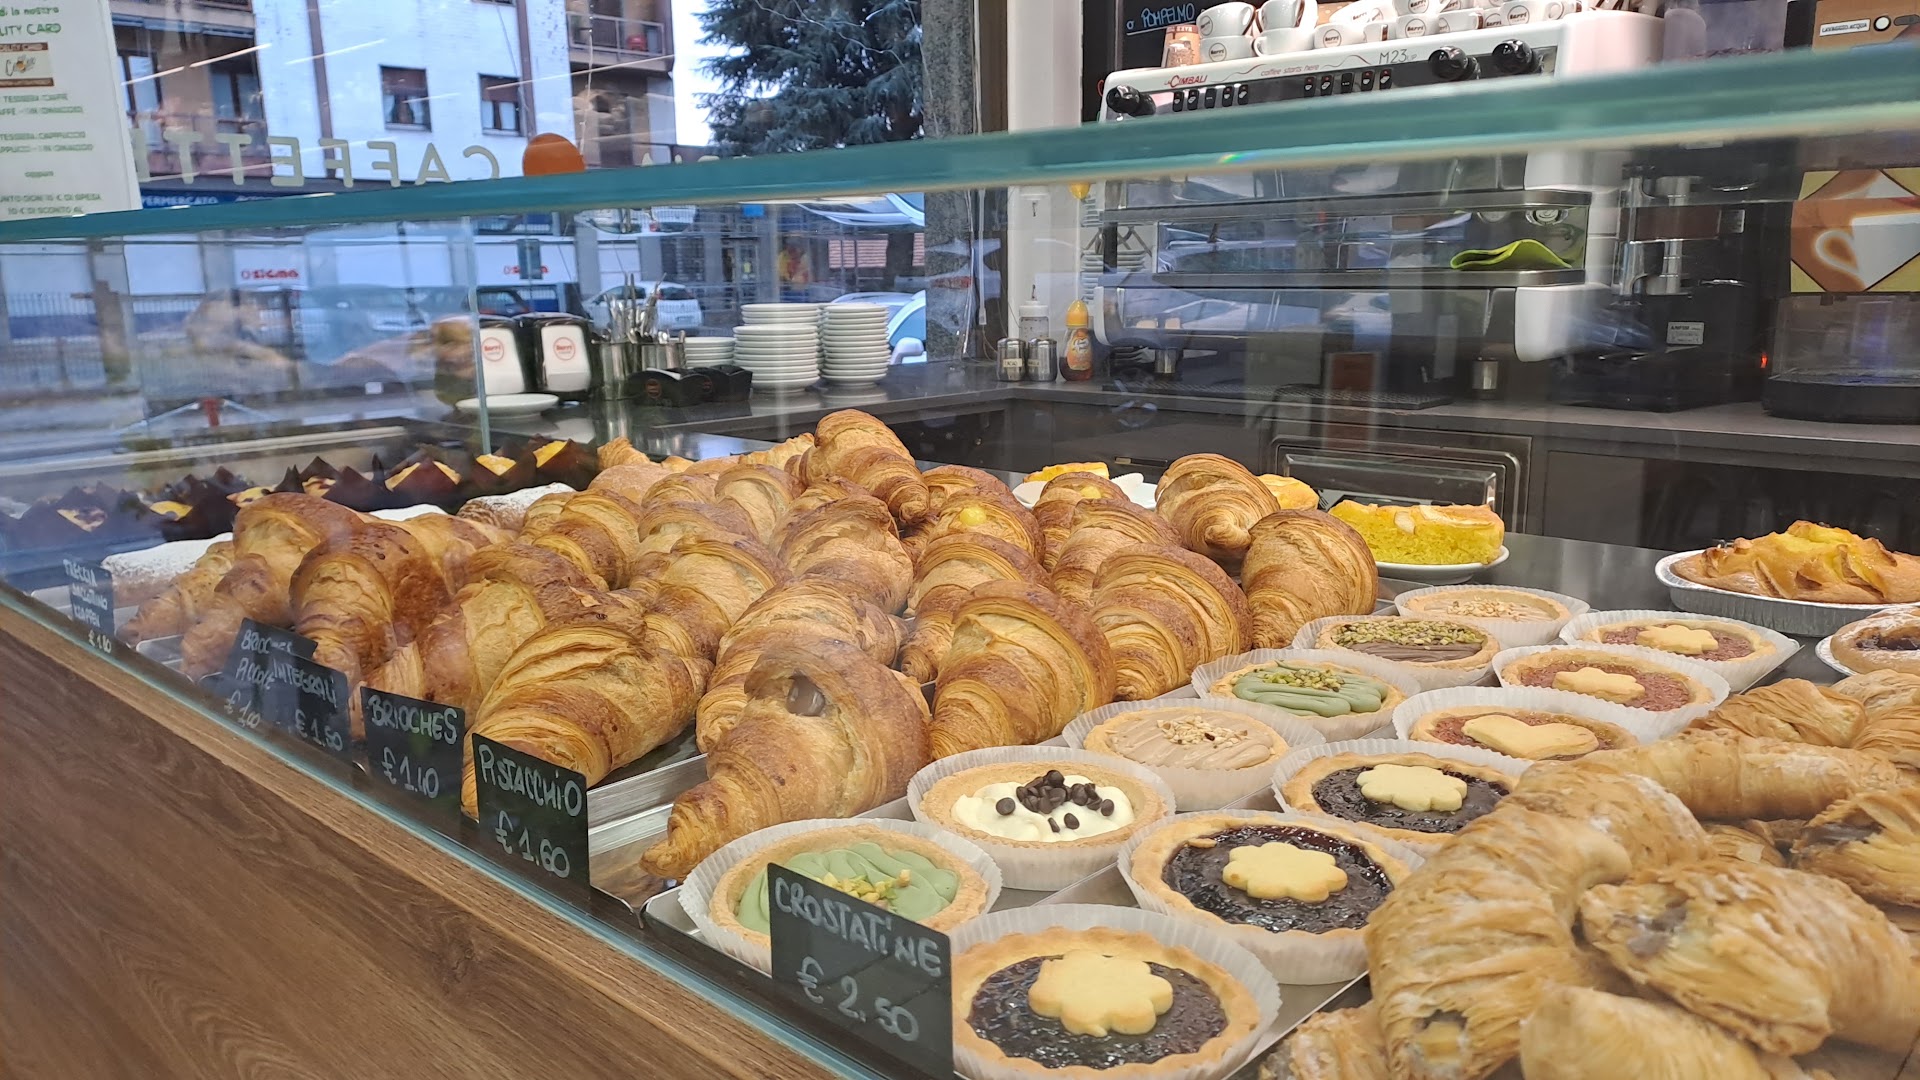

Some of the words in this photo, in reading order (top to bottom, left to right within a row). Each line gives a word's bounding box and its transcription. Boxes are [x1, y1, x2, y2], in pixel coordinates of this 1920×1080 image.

[27, 23, 62, 36] CARD
[1141, 3, 1195, 28] POMPELMO
[1260, 68, 1281, 77] coffee
[1283, 66, 1302, 75] starts
[1304, 64, 1320, 73] here
[366, 694, 458, 745] BRIOCHES
[381, 746, 397, 785] €
[478, 743, 582, 817] PISTACCHIO
[494, 810, 514, 855] €
[796, 956, 825, 1004] €
